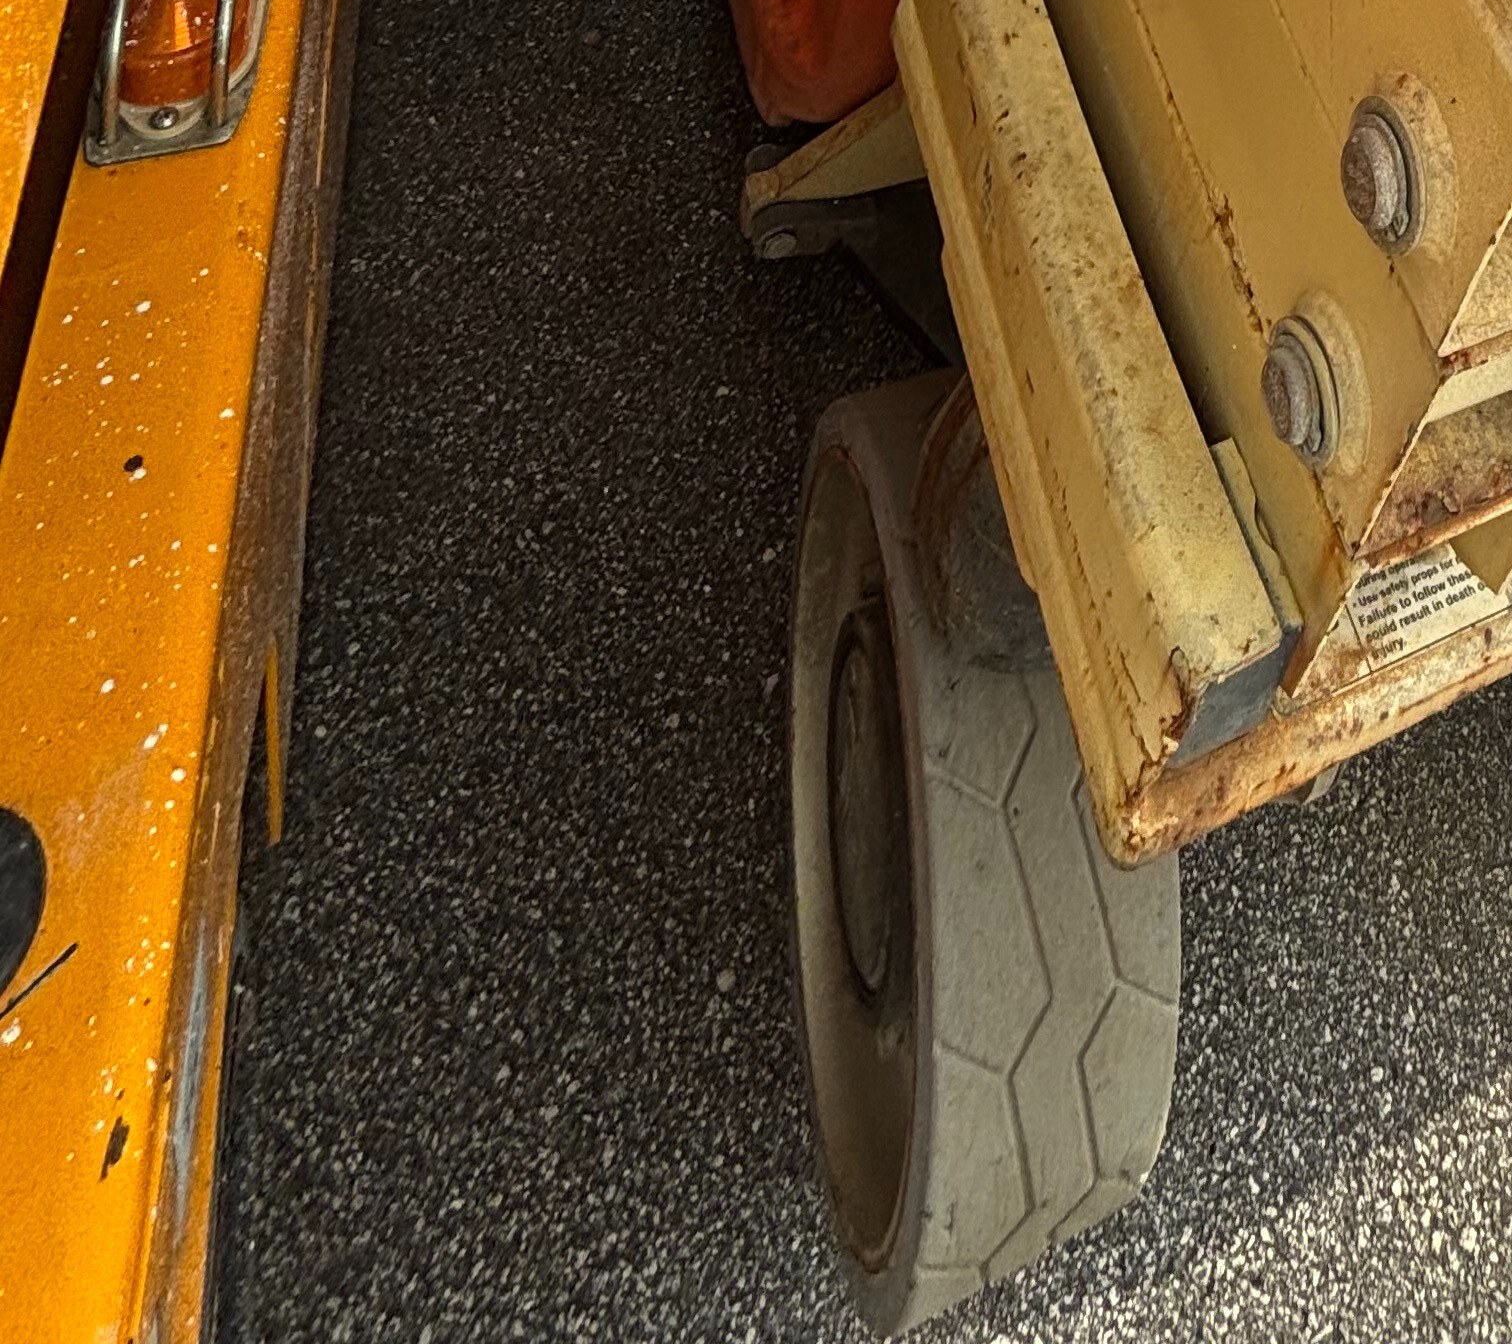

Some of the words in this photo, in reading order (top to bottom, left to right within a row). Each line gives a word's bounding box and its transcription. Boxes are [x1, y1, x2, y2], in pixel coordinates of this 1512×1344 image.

[1358, 603, 1398, 627] Failure
[1399, 597, 1412, 609] to
[1413, 581, 1446, 601] follow
[1447, 570, 1472, 587] thes
[1411, 566, 1439, 584] props
[1440, 558, 1454, 570] for
[1366, 619, 1397, 643] could
[1399, 605, 1432, 627] result
[1432, 600, 1444, 611] in
[1445, 584, 1476, 606] death
